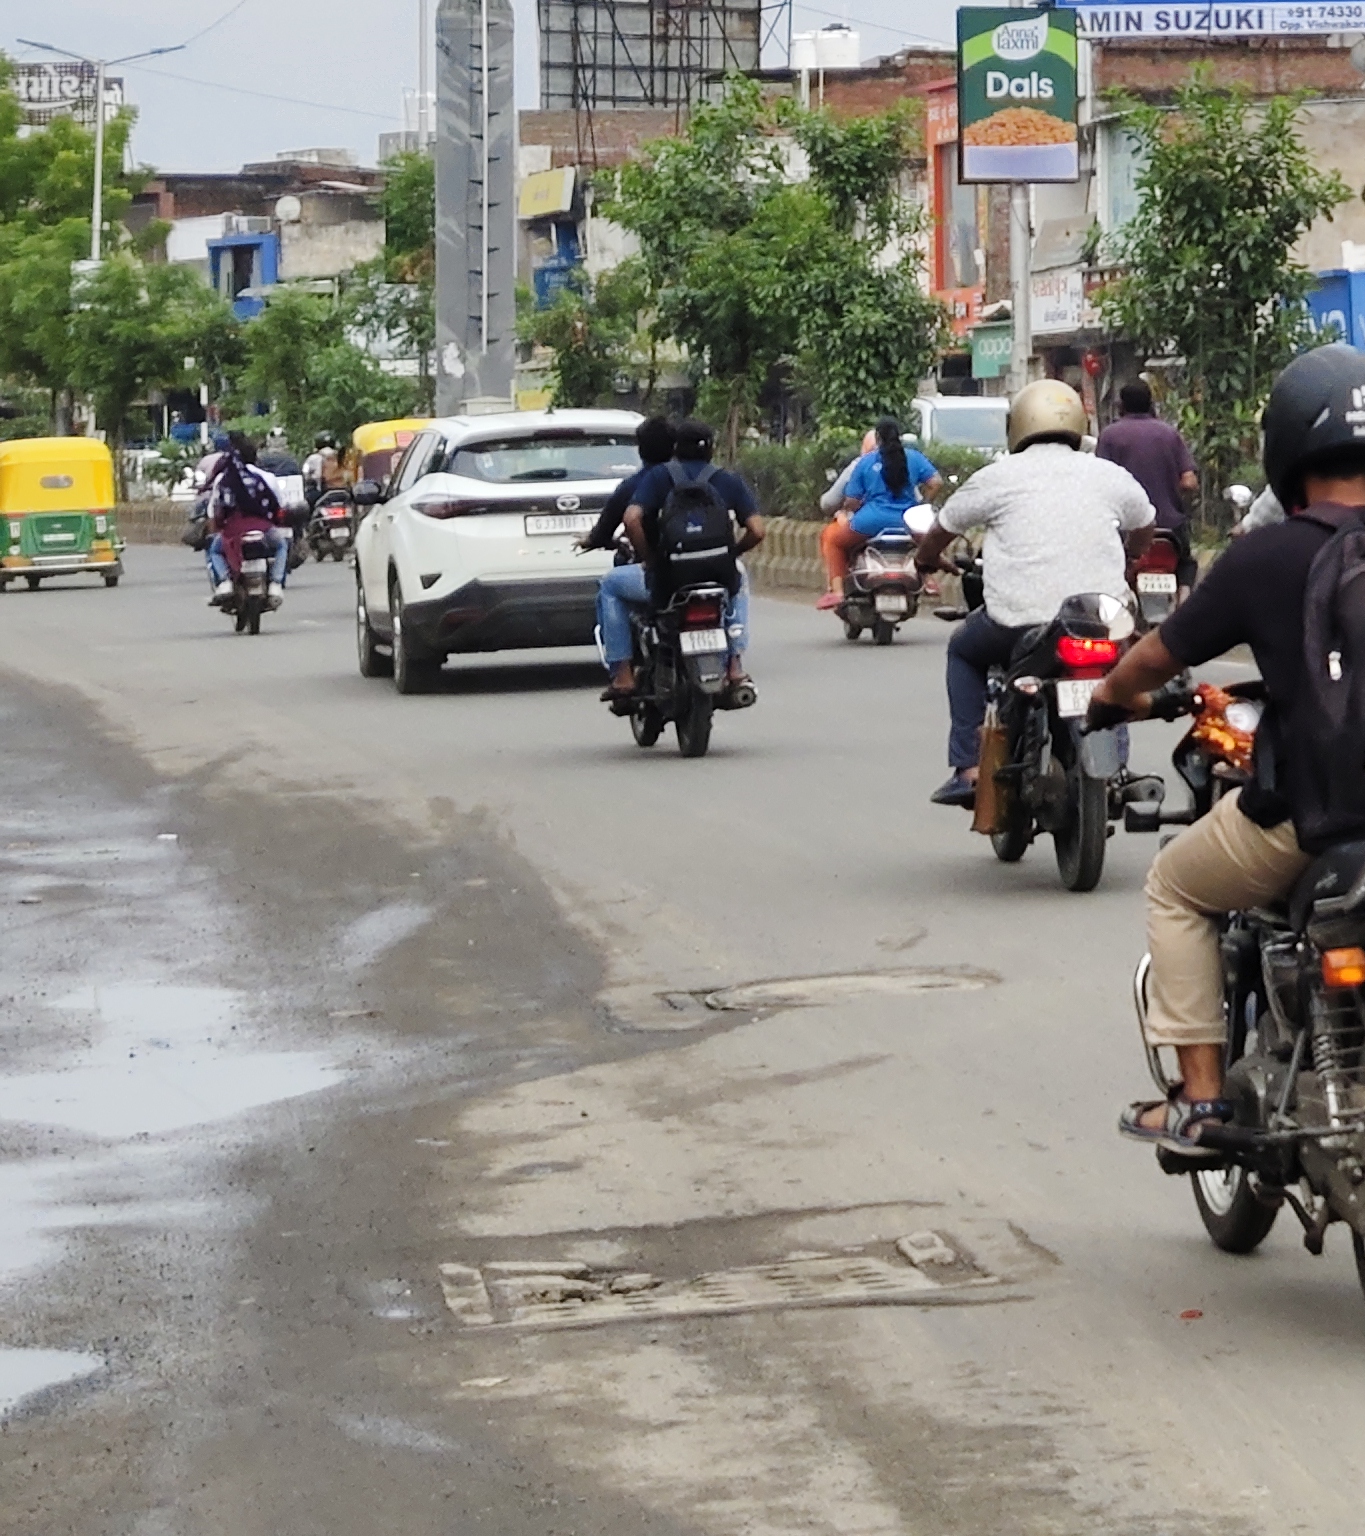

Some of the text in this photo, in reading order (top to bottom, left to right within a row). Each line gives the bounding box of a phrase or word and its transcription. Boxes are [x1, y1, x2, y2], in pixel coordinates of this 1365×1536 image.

[1318, 5, 1363, 17] 74330
[1154, 8, 1265, 32] SUZUKI
[1001, 25, 1038, 38] Anna
[997, 33, 1039, 50] laxmi
[985, 70, 1055, 99] Dals
